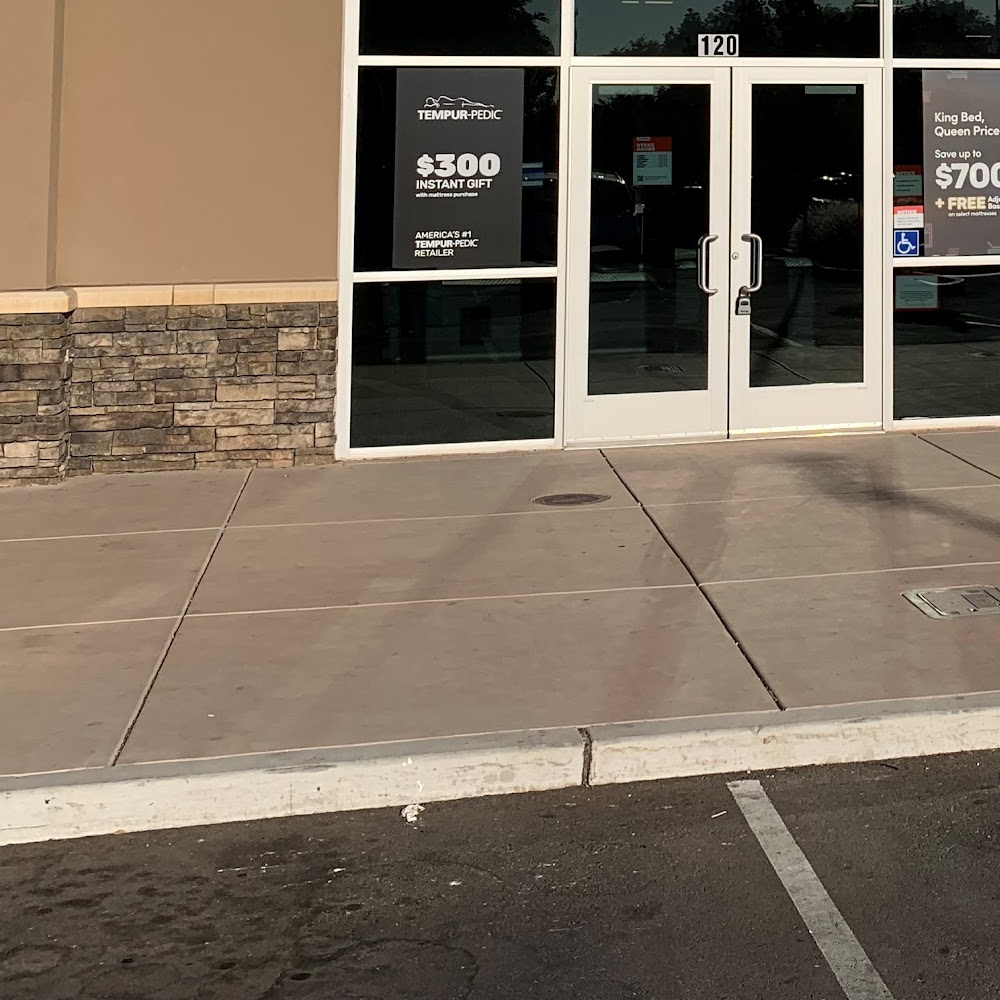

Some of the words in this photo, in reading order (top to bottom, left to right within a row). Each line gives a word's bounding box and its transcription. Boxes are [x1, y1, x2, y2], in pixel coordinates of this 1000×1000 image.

[701, 35, 737, 56] 120
[934, 112, 959, 125] King
[961, 111, 985, 124] Bed,
[934, 126, 971, 138] Queen
[973, 125, 1000, 136] Price
[934, 149, 957, 159] Save
[959, 151, 971, 160] up
[972, 149, 982, 158] to
[416, 153, 501, 178] $300
[416, 179, 465, 190] INSTANT
[467, 179, 493, 189] GIFT
[947, 196, 987, 210] FREE
[415, 230, 460, 239] AMERICA'S
[461, 230, 472, 238] #1
[414, 249, 454, 257] RETAILER
